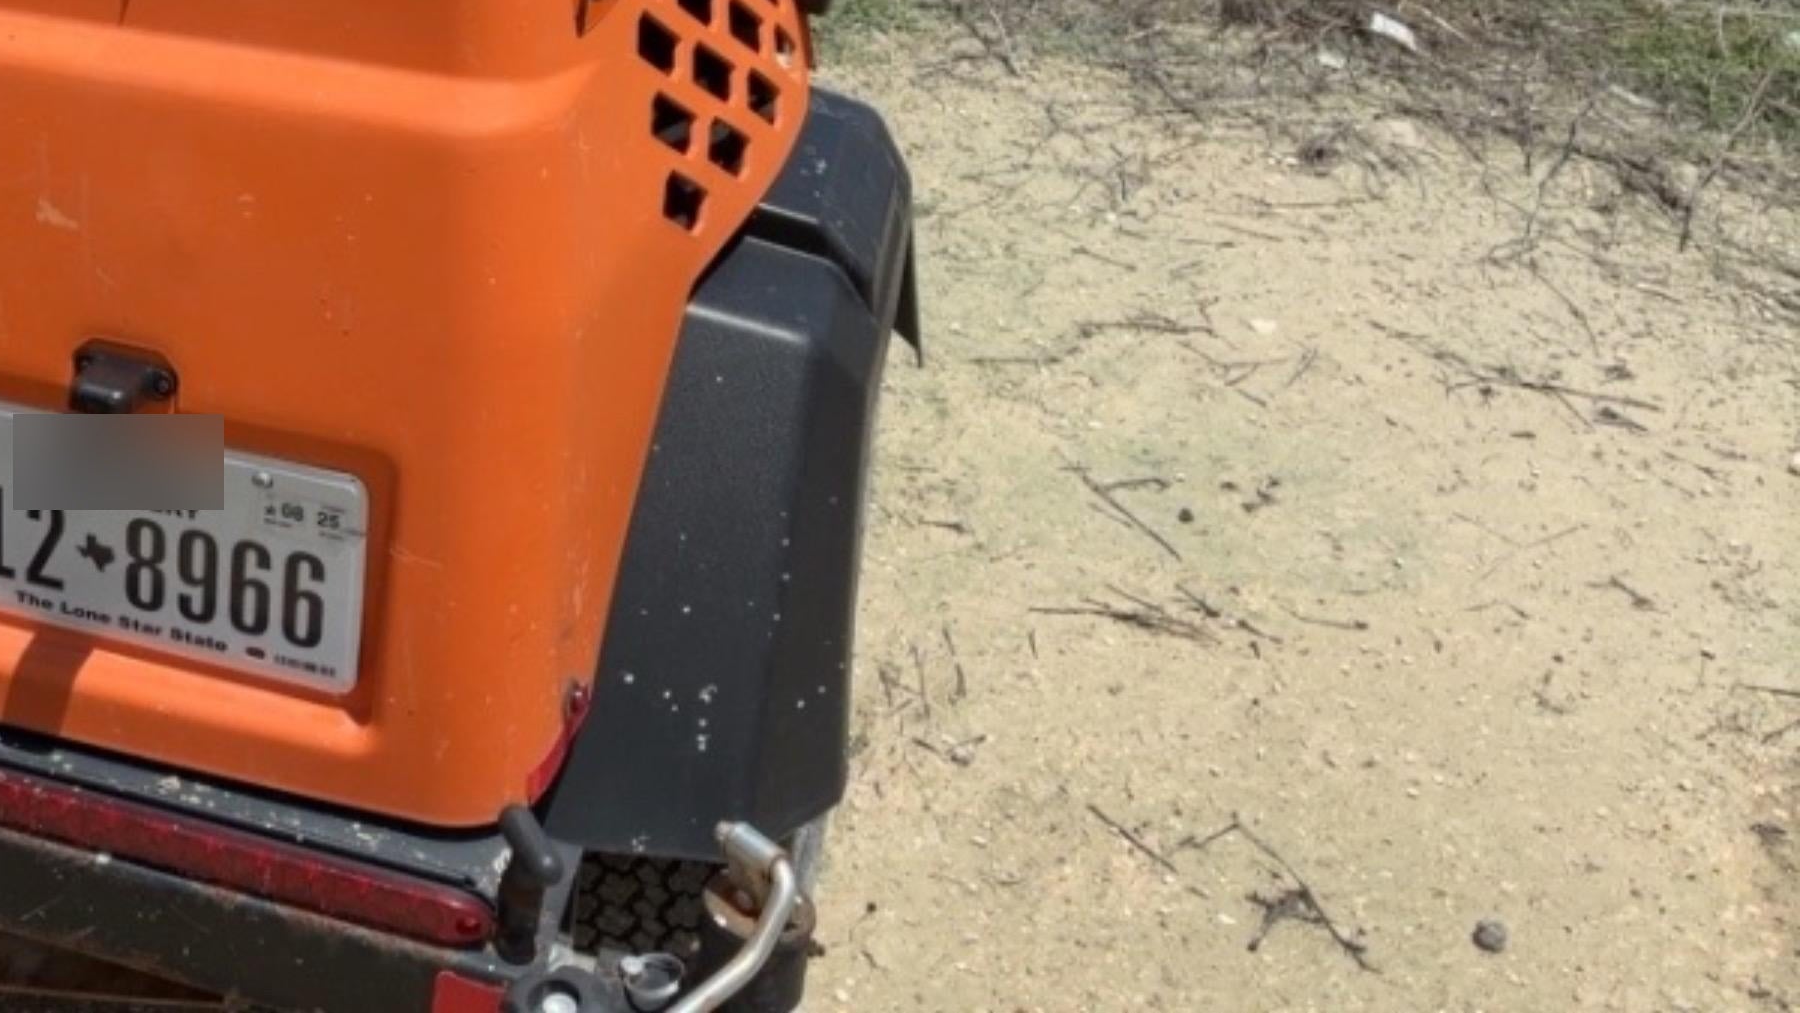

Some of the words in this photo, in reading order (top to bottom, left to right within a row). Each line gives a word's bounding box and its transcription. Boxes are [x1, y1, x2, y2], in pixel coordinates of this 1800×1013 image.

[16, 590, 53, 610] The
[61, 600, 112, 625] Lone
[118, 615, 164, 638] Star
[170, 626, 229, 654] State
[125, 517, 326, 649] 8966
